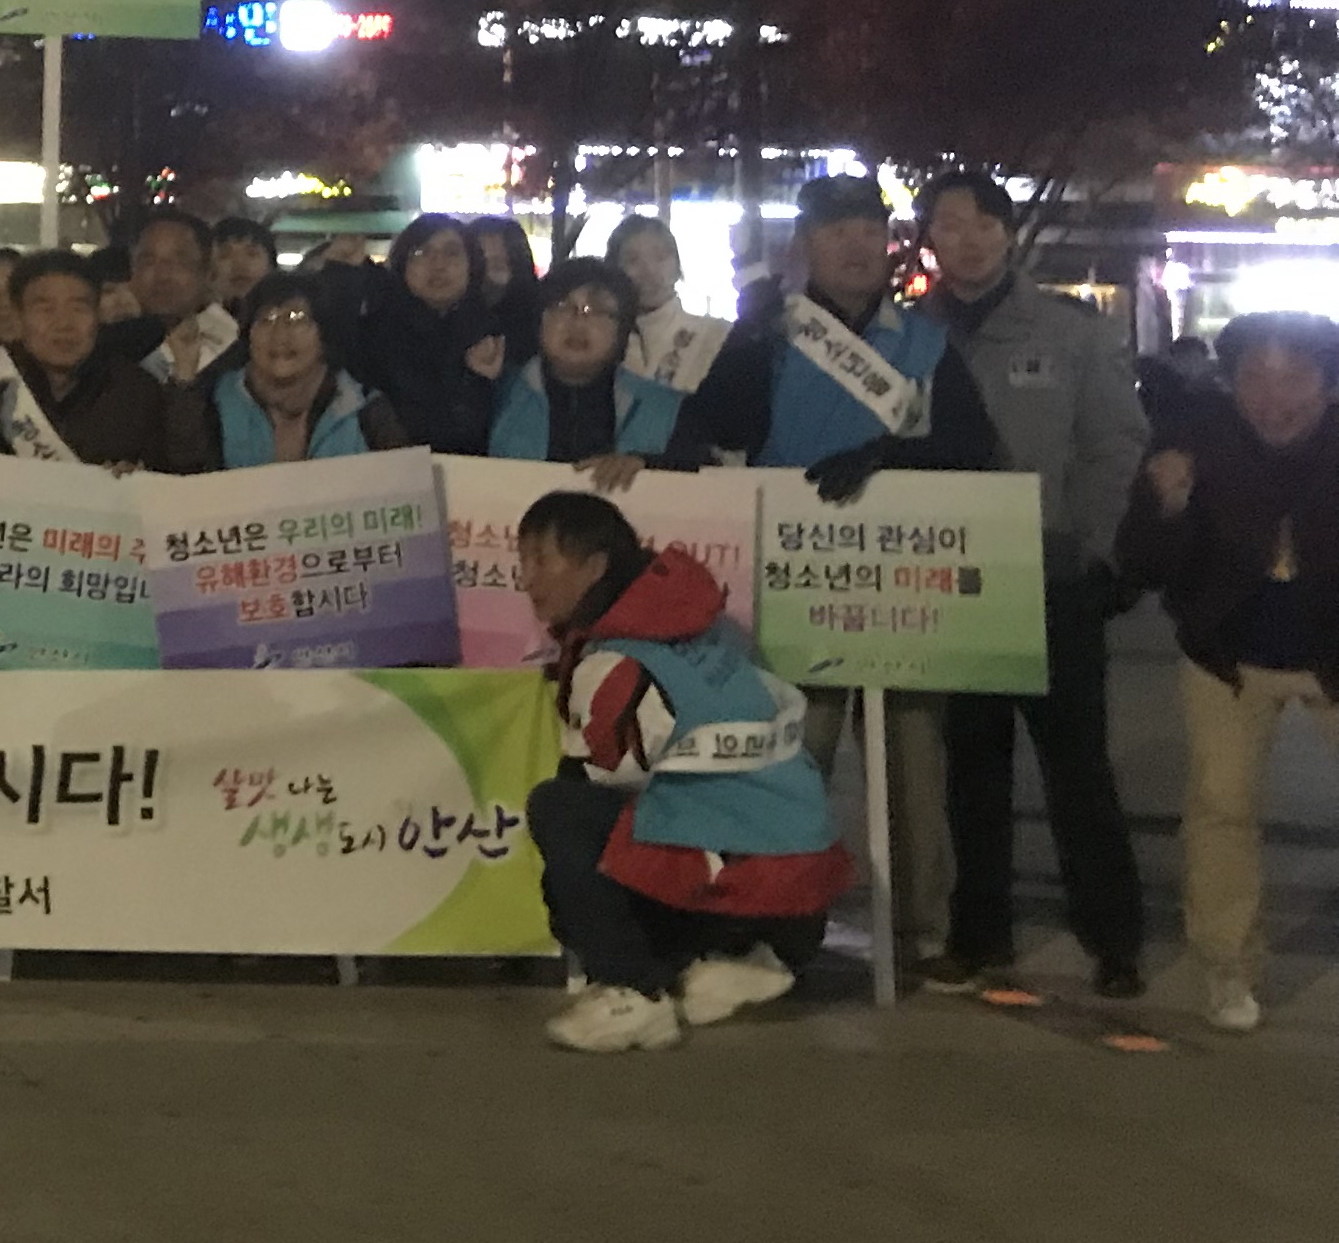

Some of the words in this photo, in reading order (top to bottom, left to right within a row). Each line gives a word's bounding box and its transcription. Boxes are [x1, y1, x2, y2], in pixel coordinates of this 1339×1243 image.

[42, 527, 123, 559] 미래의
[165, 521, 268, 562] 청소년은
[277, 511, 355, 546] 우리의
[776, 521, 866, 555] 당신의
[875, 524, 968, 557] 관심이
[194, 541, 403, 595] 유해환경으로부터
[764, 562, 884, 593] 청소년의
[893, 564, 983, 597] 미래를
[238, 584, 369, 624] 보호합시다
[398, 803, 520, 859] 안산
